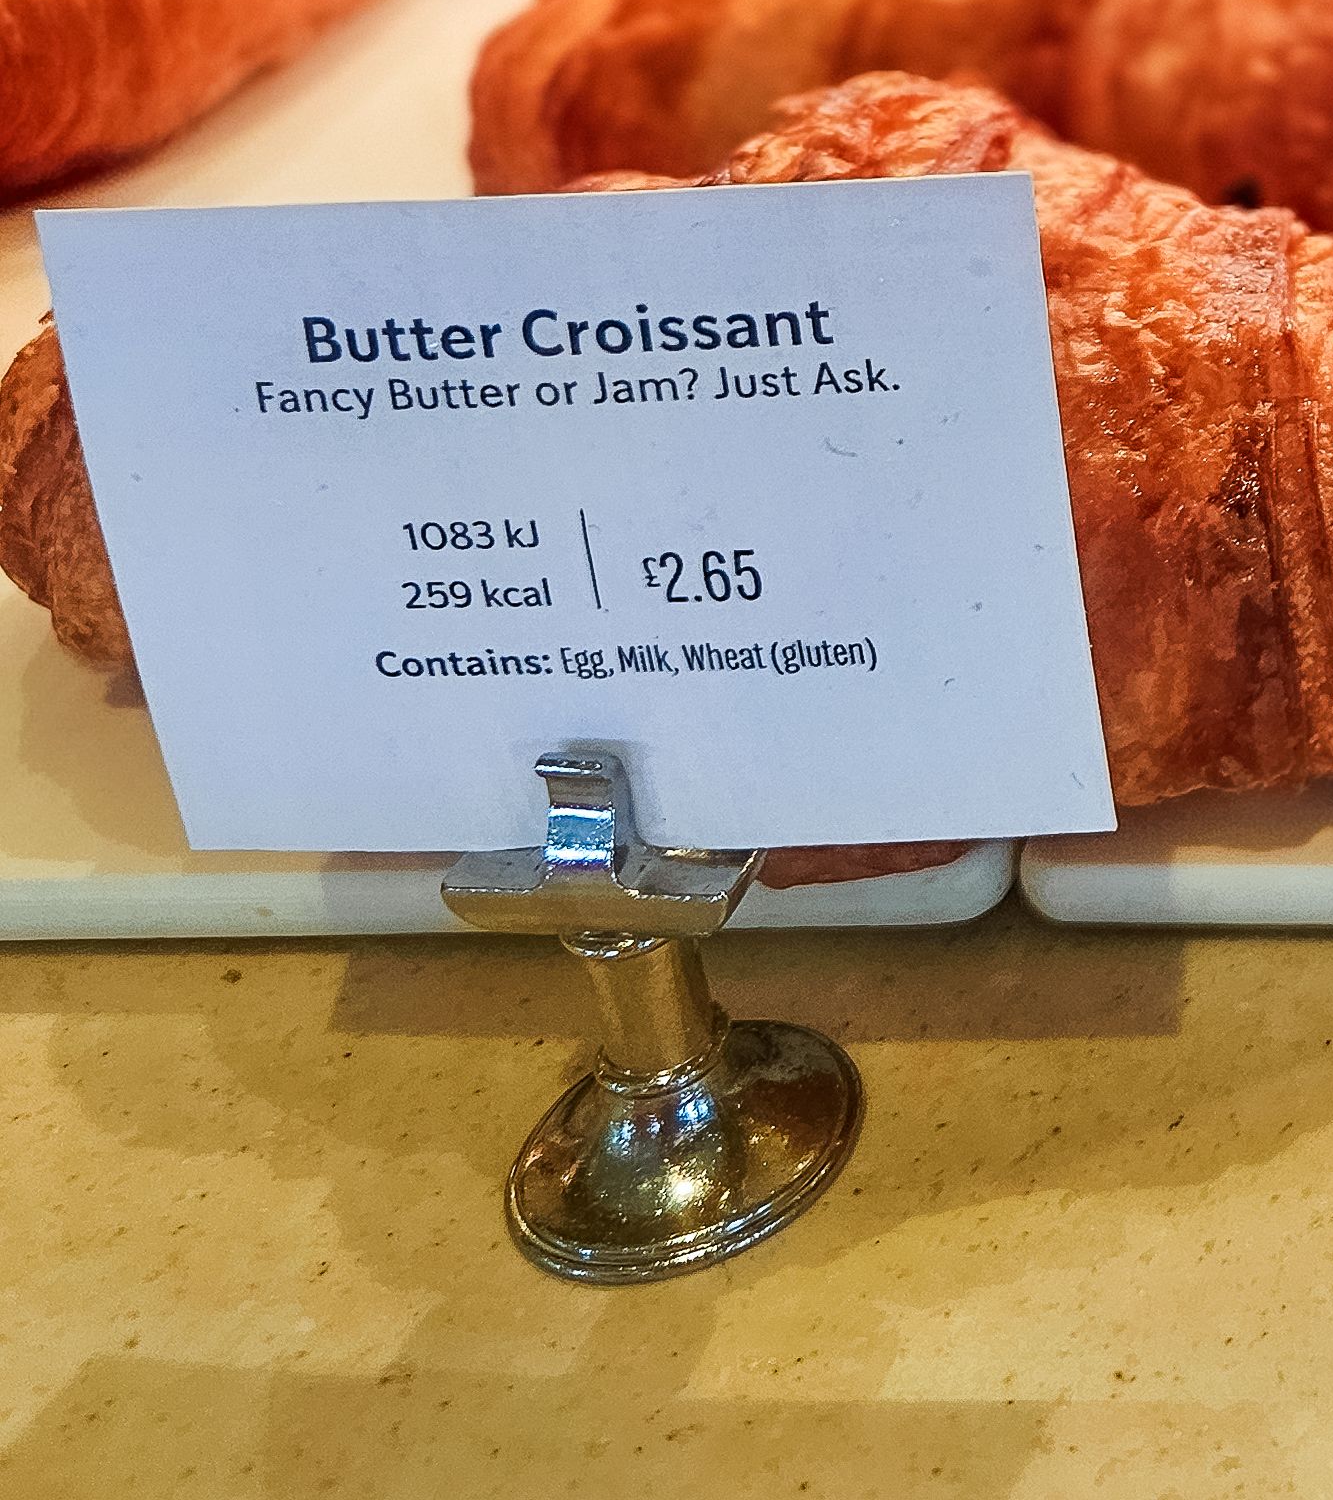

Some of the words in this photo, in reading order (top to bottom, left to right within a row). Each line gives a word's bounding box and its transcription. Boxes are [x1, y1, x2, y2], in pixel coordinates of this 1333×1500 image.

[301, 316, 503, 364] Butter
[521, 300, 835, 357] Croissant
[254, 381, 375, 421] Fancy
[387, 377, 521, 411] Butter
[534, 380, 578, 407] or
[592, 366, 699, 405] Jam?
[713, 365, 802, 400] Just
[812, 358, 901, 396] Ask.
[402, 520, 496, 551] 1083
[503, 518, 540, 549] kJ
[400, 580, 473, 610] 259
[480, 577, 553, 608] kcal
[641, 548, 763, 604] £2.65
[375, 648, 554, 678] Contains:
[559, 646, 615, 680] Egg,
[616, 643, 680, 678] Milk,
[681, 642, 768, 673] Wheat
[768, 636, 878, 676] (gluten)
